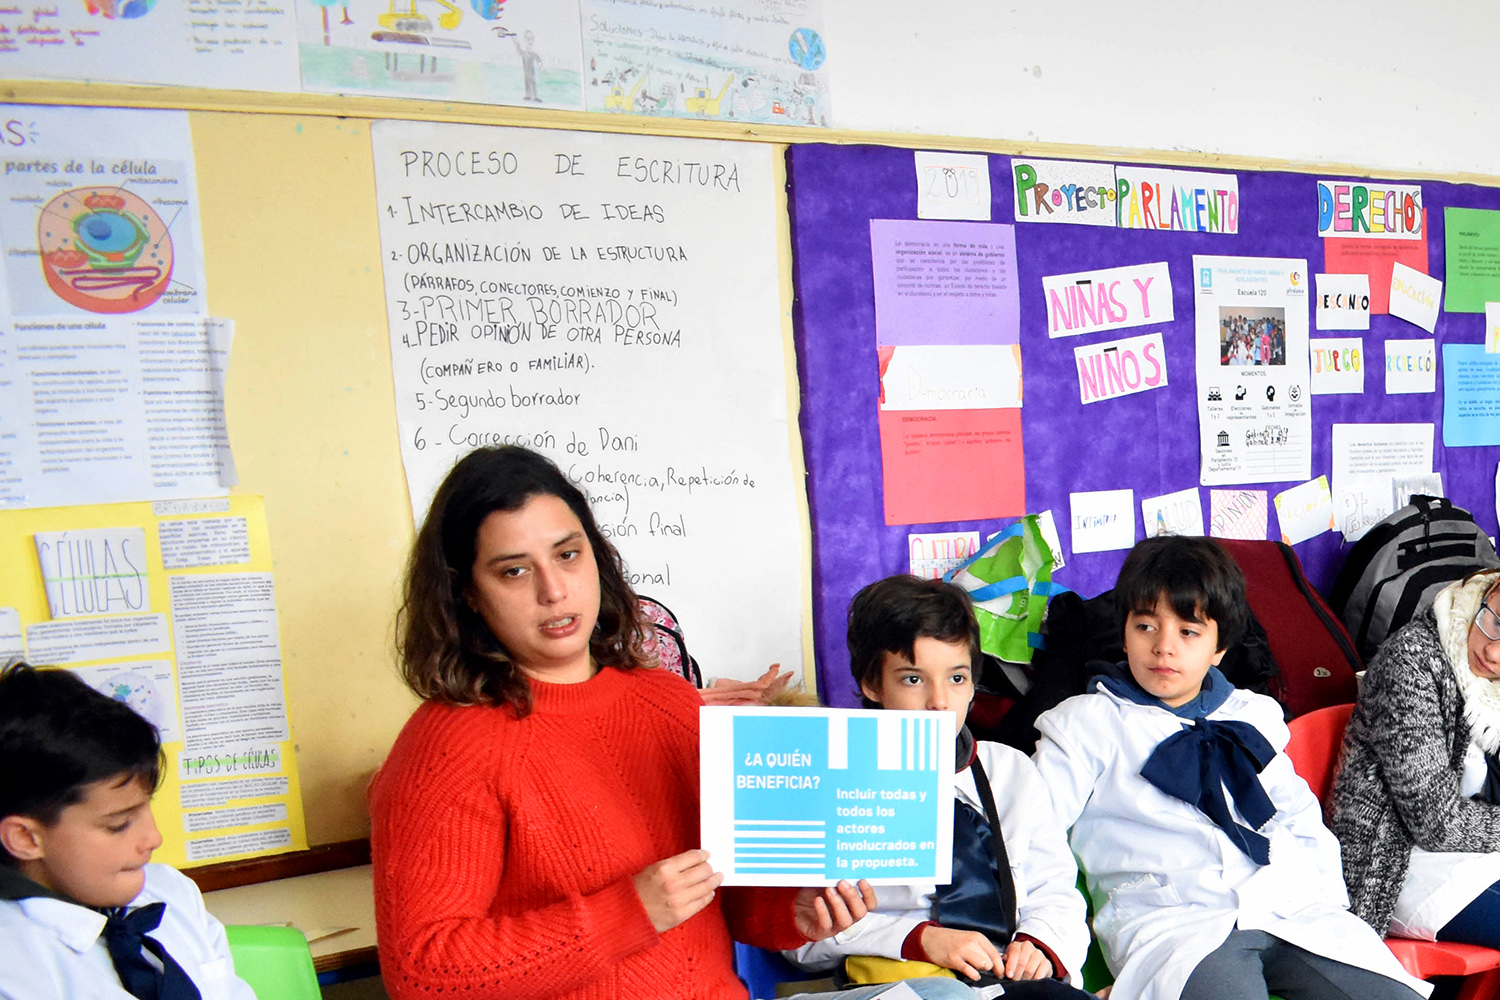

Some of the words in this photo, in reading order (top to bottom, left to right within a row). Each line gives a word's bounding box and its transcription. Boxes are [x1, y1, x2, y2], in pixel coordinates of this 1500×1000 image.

[5, 160, 57, 176] partes
[64, 159, 84, 174] de
[91, 160, 105, 174] la
[112, 160, 157, 175] célula
[400, 150, 518, 177] PROCESO
[555, 153, 584, 176] DE
[402, 196, 543, 225] INTERCAMBIO
[559, 203, 590, 220] DE
[601, 203, 665, 224] IDEAS
[1117, 178, 1238, 232] PARLAMENTO
[1318, 183, 1423, 235] DERECHOS
[407, 238, 531, 264] ORGANIZACIÓN
[543, 246, 561, 261] DE
[571, 246, 588, 260] LA
[597, 245, 688, 263] ESTRUCTURA
[561, 284, 621, 299] COMIENZO
[627, 289, 634, 300] Y
[641, 287, 678, 307] FINAL)
[1050, 279, 1128, 332] NIÑAS
[1133, 276, 1155, 318] Y
[1237, 288, 1258, 297] Escuela
[1258, 289, 1267, 297] 120
[1317, 293, 1369, 310] DESCANSO
[419, 294, 518, 324] PRIMER
[526, 296, 660, 331] BORRADOR
[416, 320, 460, 347] PEDIR
[471, 320, 532, 345] OPINIÓN
[541, 322, 557, 339] DE
[566, 326, 602, 343] OTRA
[614, 324, 681, 348] PERSONA
[510, 361, 518, 373] O
[1078, 342, 1162, 400] NIÑOS
[1313, 347, 1360, 373] JUEGO
[434, 388, 505, 418] Segundo
[509, 384, 580, 408] borrador
[566, 431, 589, 456] de
[599, 427, 638, 451] Dani
[667, 466, 739, 494] Repetición
[743, 473, 756, 488] de
[649, 511, 687, 538] final
[1145, 500, 1200, 537] SALUD
[225, 753, 238, 771] DE
[745, 753, 763, 768] ¿A
[766, 749, 812, 768] QUIÉN
[736, 775, 821, 789] BENEFICIA?
[836, 788, 877, 800] Incluir
[881, 788, 917, 800] todas
[919, 791, 927, 803] y
[836, 806, 873, 818] todos
[876, 806, 895, 817] los
[836, 823, 885, 834] actores
[836, 839, 916, 851] involucrados
[919, 842, 935, 851] en
[836, 856, 849, 868] la
[852, 856, 919, 871] propuesta.
